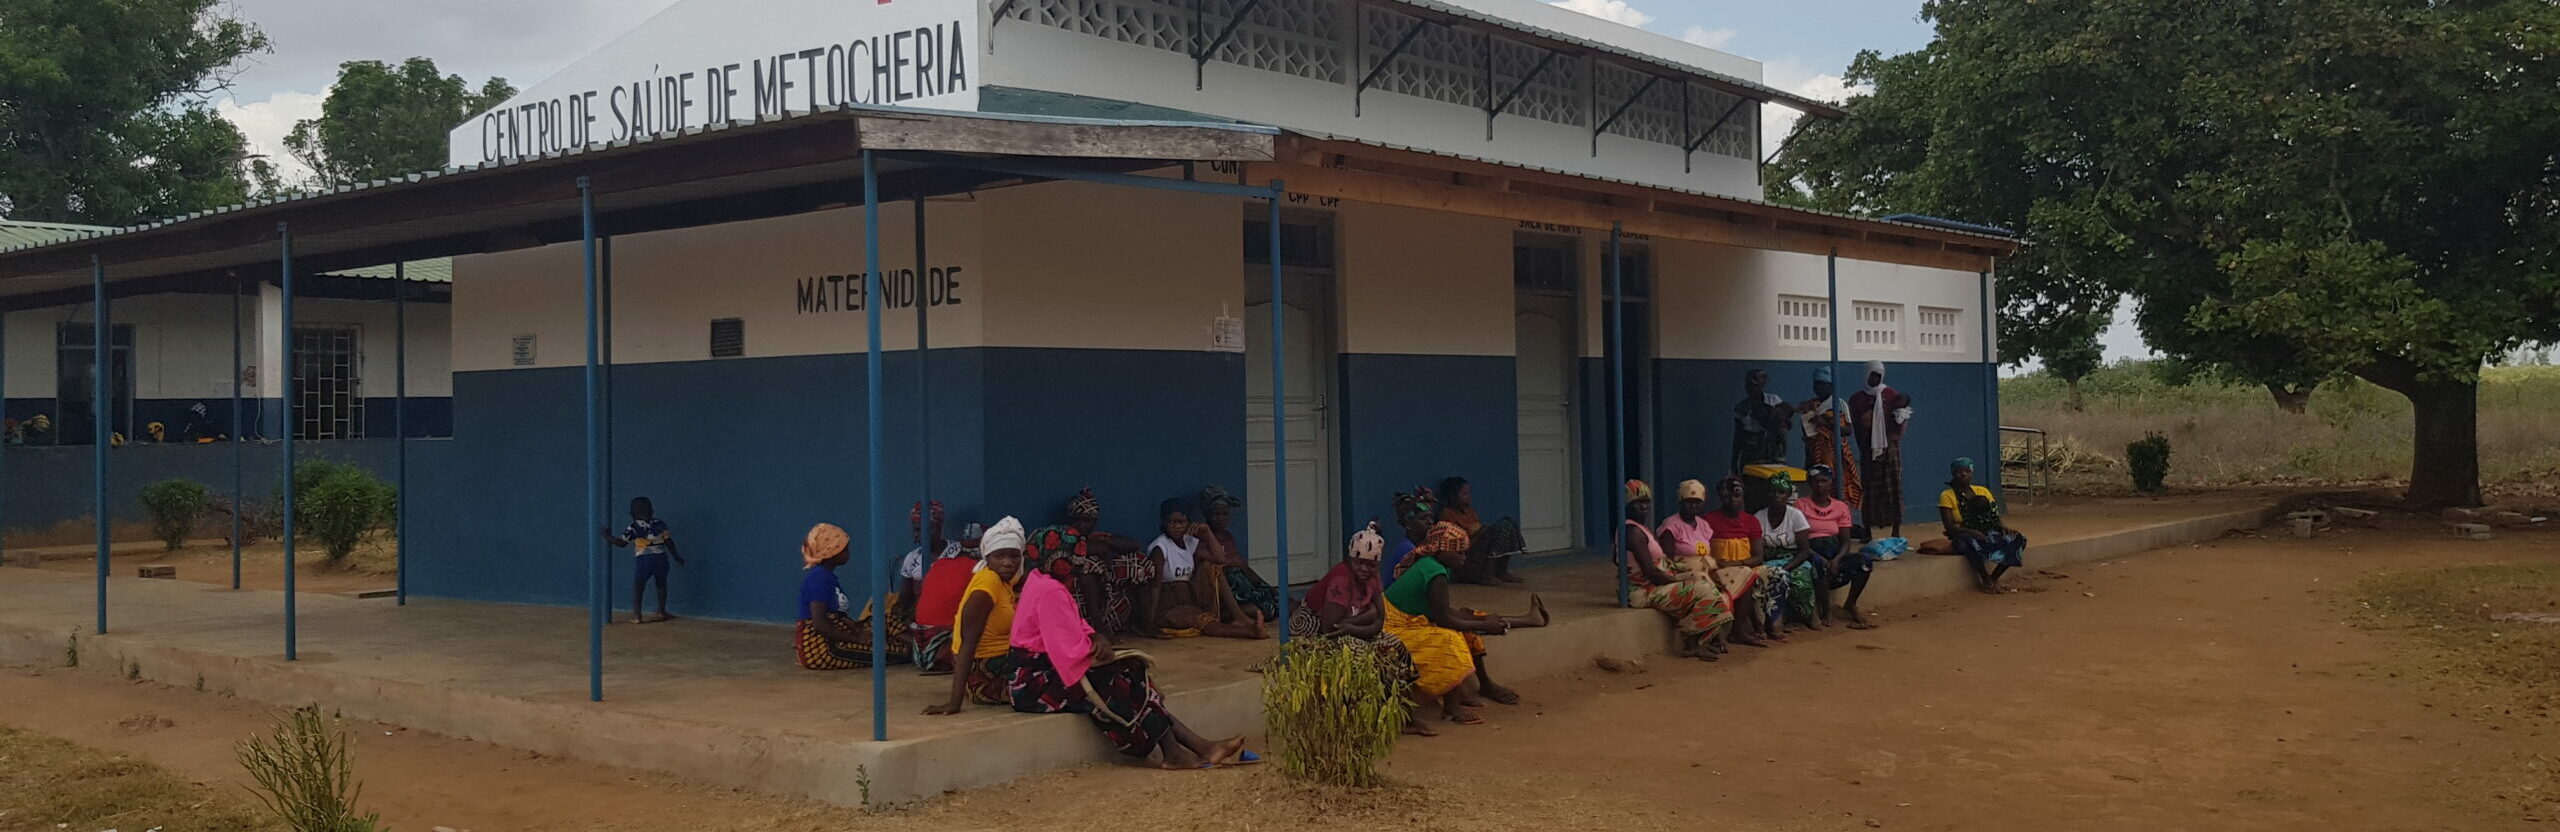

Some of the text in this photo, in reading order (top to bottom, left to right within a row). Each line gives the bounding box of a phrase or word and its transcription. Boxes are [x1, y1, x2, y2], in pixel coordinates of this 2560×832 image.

[483, 20, 967, 162] CENTRO DE SAÚDE DE METOCHERIA
[797, 267, 962, 314] MATENIDDE
